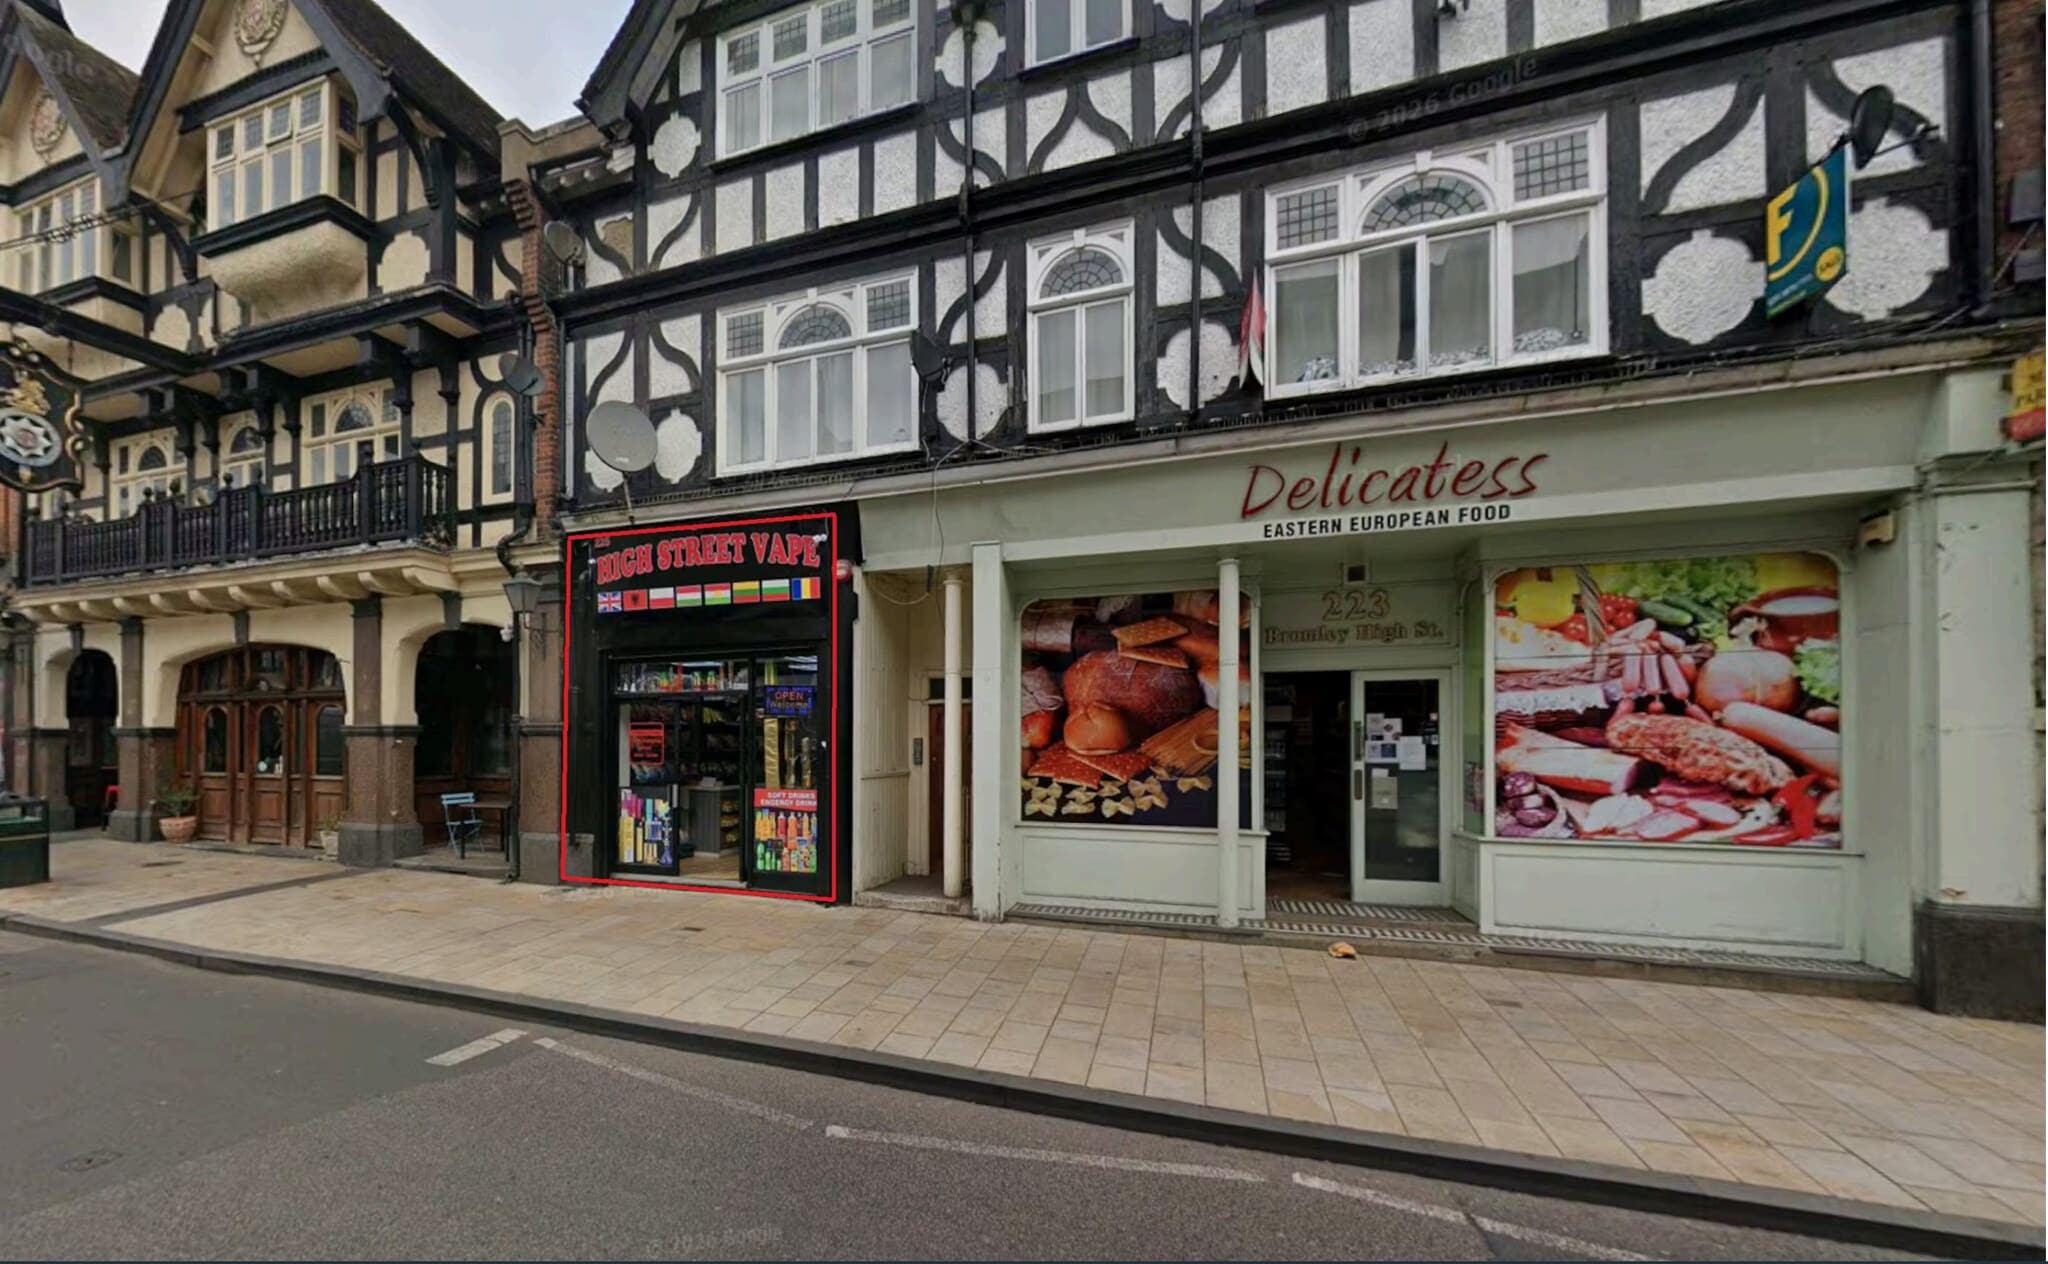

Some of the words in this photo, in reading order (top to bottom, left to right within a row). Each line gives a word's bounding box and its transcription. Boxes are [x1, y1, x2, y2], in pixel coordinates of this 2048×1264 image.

[1767, 182, 1798, 266] F
[1241, 440, 1549, 519] Delicatess
[1263, 517, 1342, 539] EASTERN
[1349, 508, 1450, 532] EUROPEAN
[1458, 503, 1511, 523] FOOD
[597, 543, 653, 585] HIGH
[657, 533, 747, 571] STREET
[750, 532, 821, 569] VAPE
[1322, 589, 1390, 622] 223
[1265, 624, 1350, 645] Bromley
[1355, 621, 1409, 644] High
[1413, 620, 1445, 639] St.
[775, 691, 804, 701] OPEN
[767, 792, 786, 800] SOFT
[788, 792, 816, 800] DRINKS
